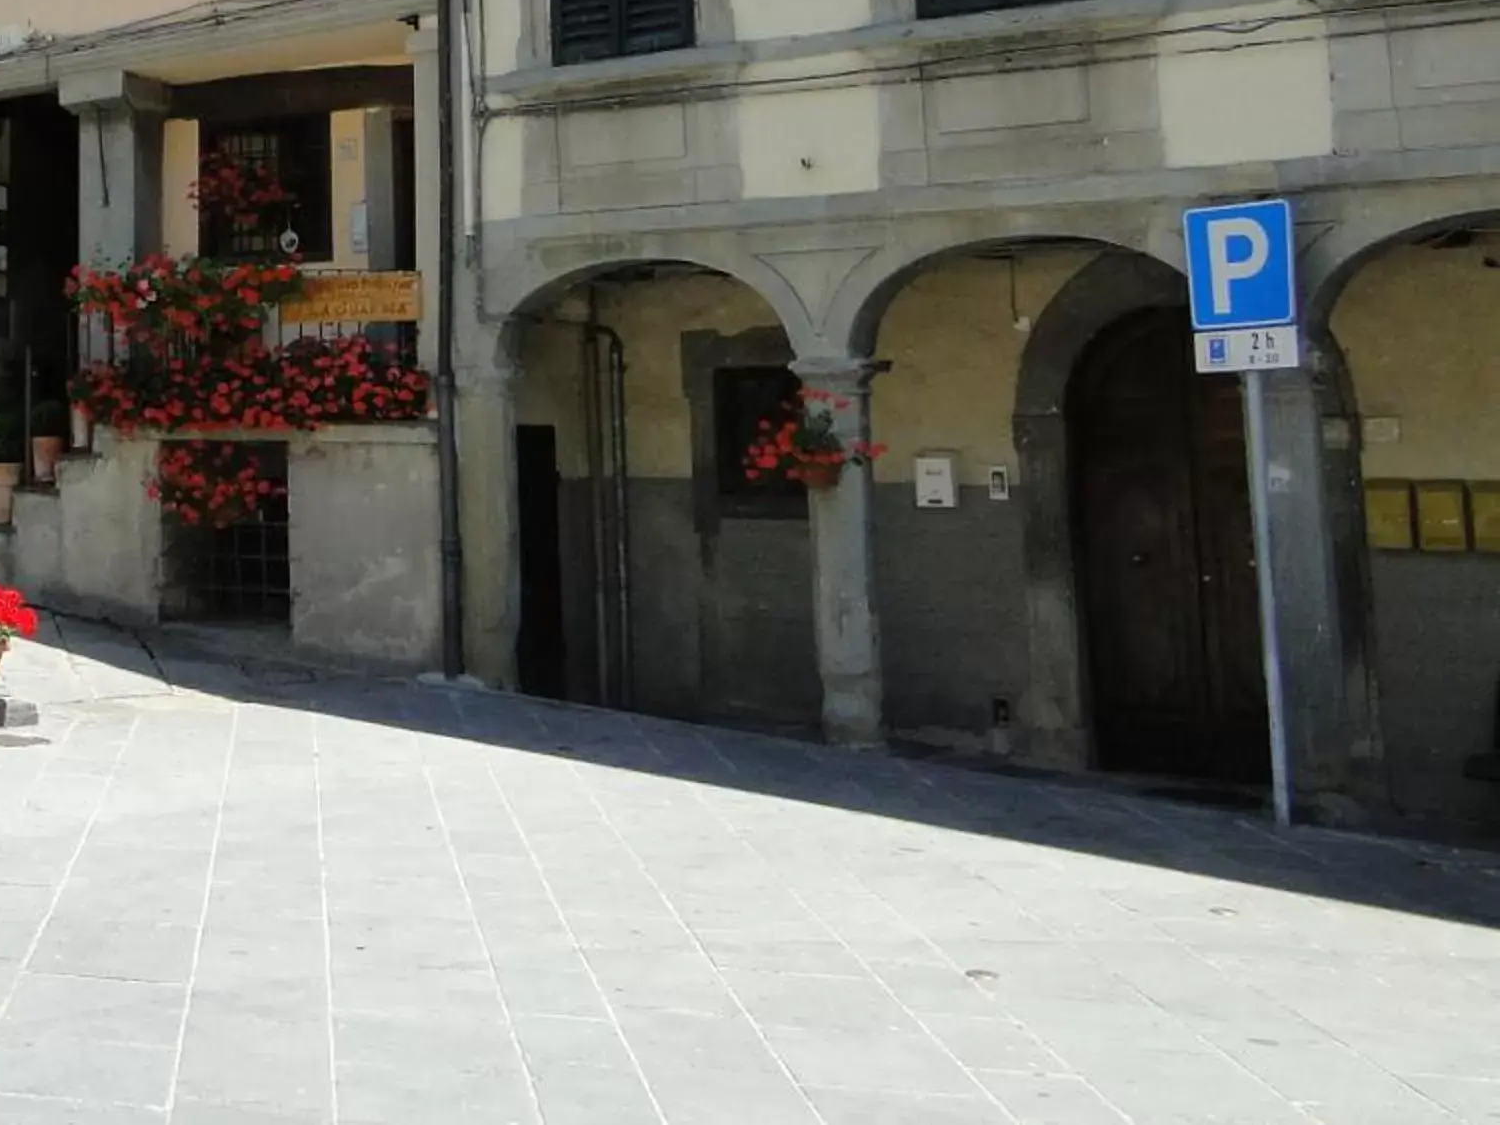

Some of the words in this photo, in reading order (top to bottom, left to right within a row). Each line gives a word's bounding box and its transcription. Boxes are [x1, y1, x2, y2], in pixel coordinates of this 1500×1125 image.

[1208, 217, 1269, 315] P
[1251, 332, 1260, 350] 2
[1265, 331, 1275, 349] h
